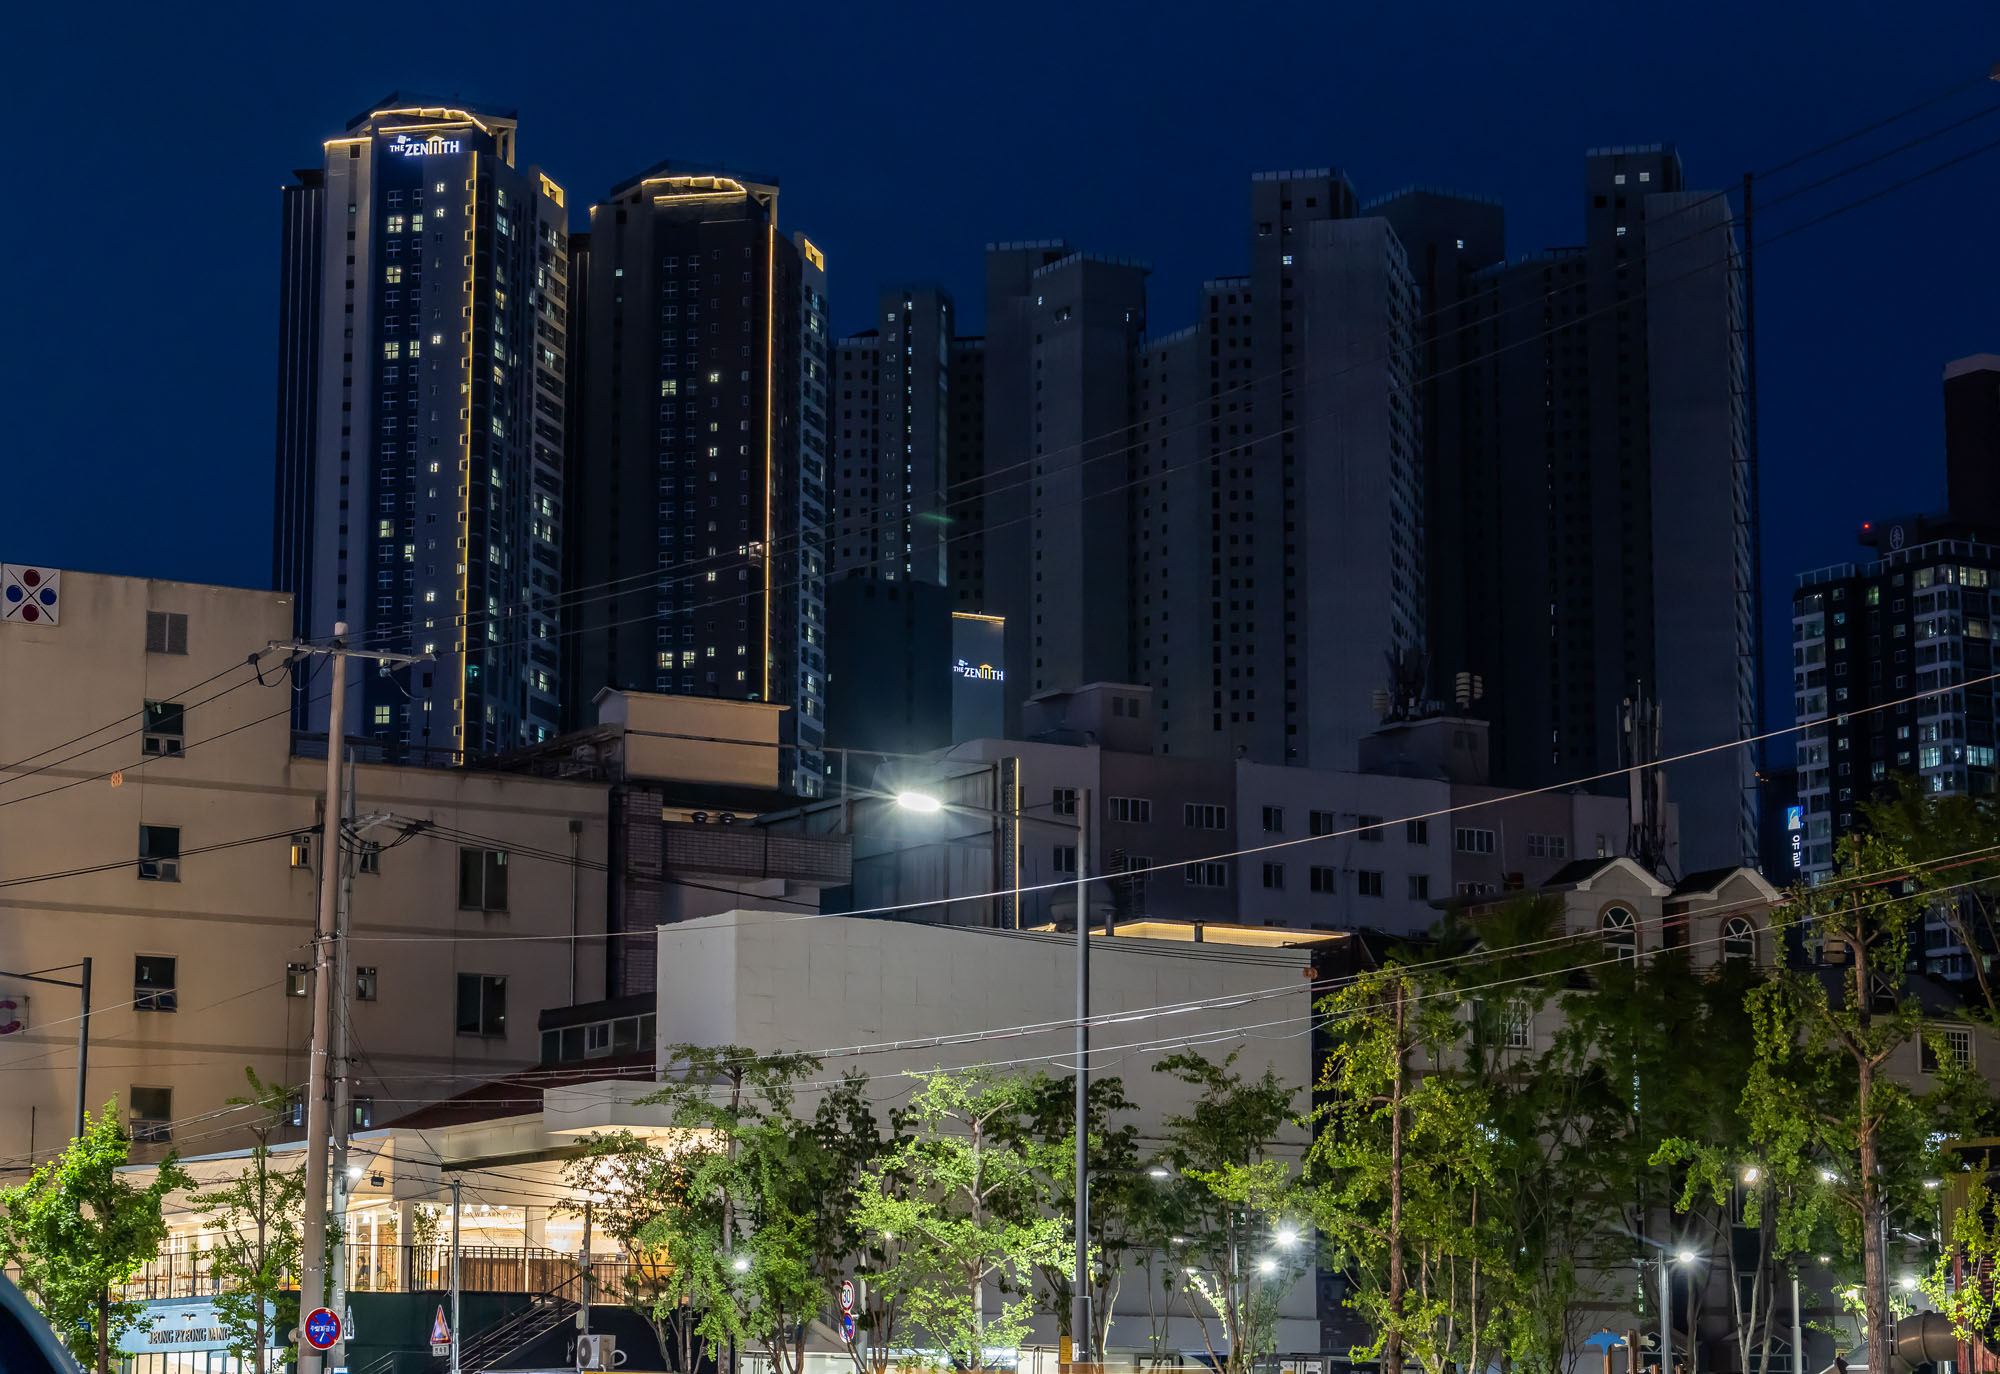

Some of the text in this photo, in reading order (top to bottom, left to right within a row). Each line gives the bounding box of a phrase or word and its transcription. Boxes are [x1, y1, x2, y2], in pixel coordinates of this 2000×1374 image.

[390, 135, 460, 156] THE ZENITH
[953, 664, 1004, 680] THE ZENITH
[1792, 834, 1801, 868] 유림
[843, 1289, 850, 1303] 30
[148, 1329, 174, 1344] JEONG
[174, 1327, 207, 1343] PYEONG
